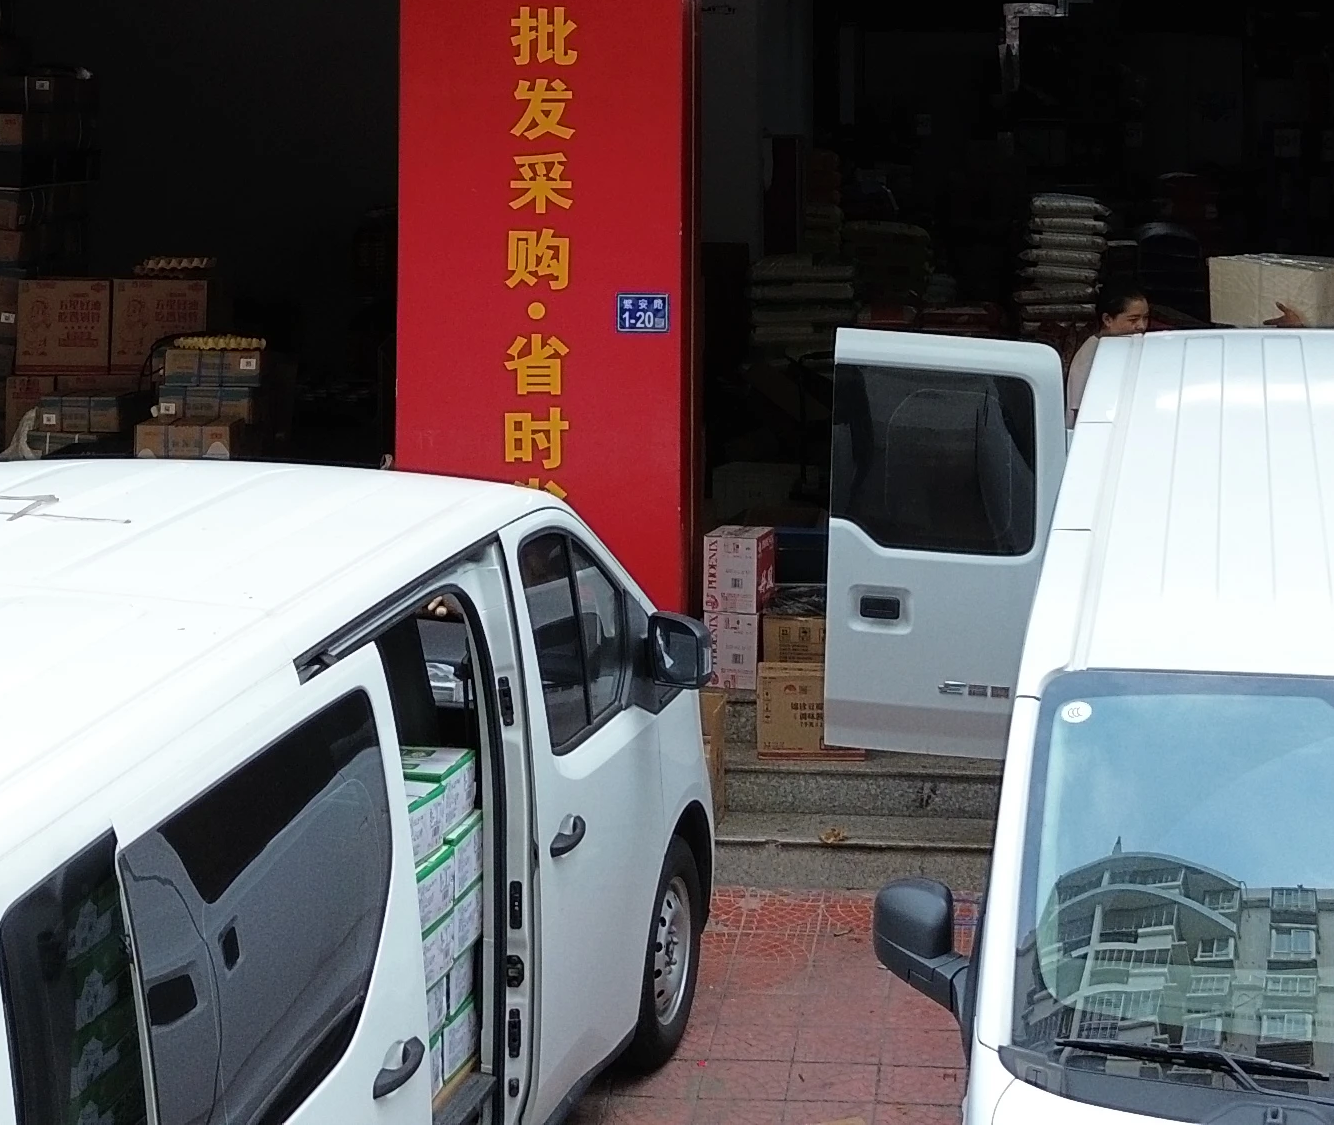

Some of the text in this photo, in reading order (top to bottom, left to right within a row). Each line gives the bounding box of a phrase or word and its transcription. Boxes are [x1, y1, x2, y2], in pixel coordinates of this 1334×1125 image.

[503, 6, 578, 500] 批发采购·省时
[622, 311, 654, 328] 1-20
[707, 539, 718, 590] PHOENIX
